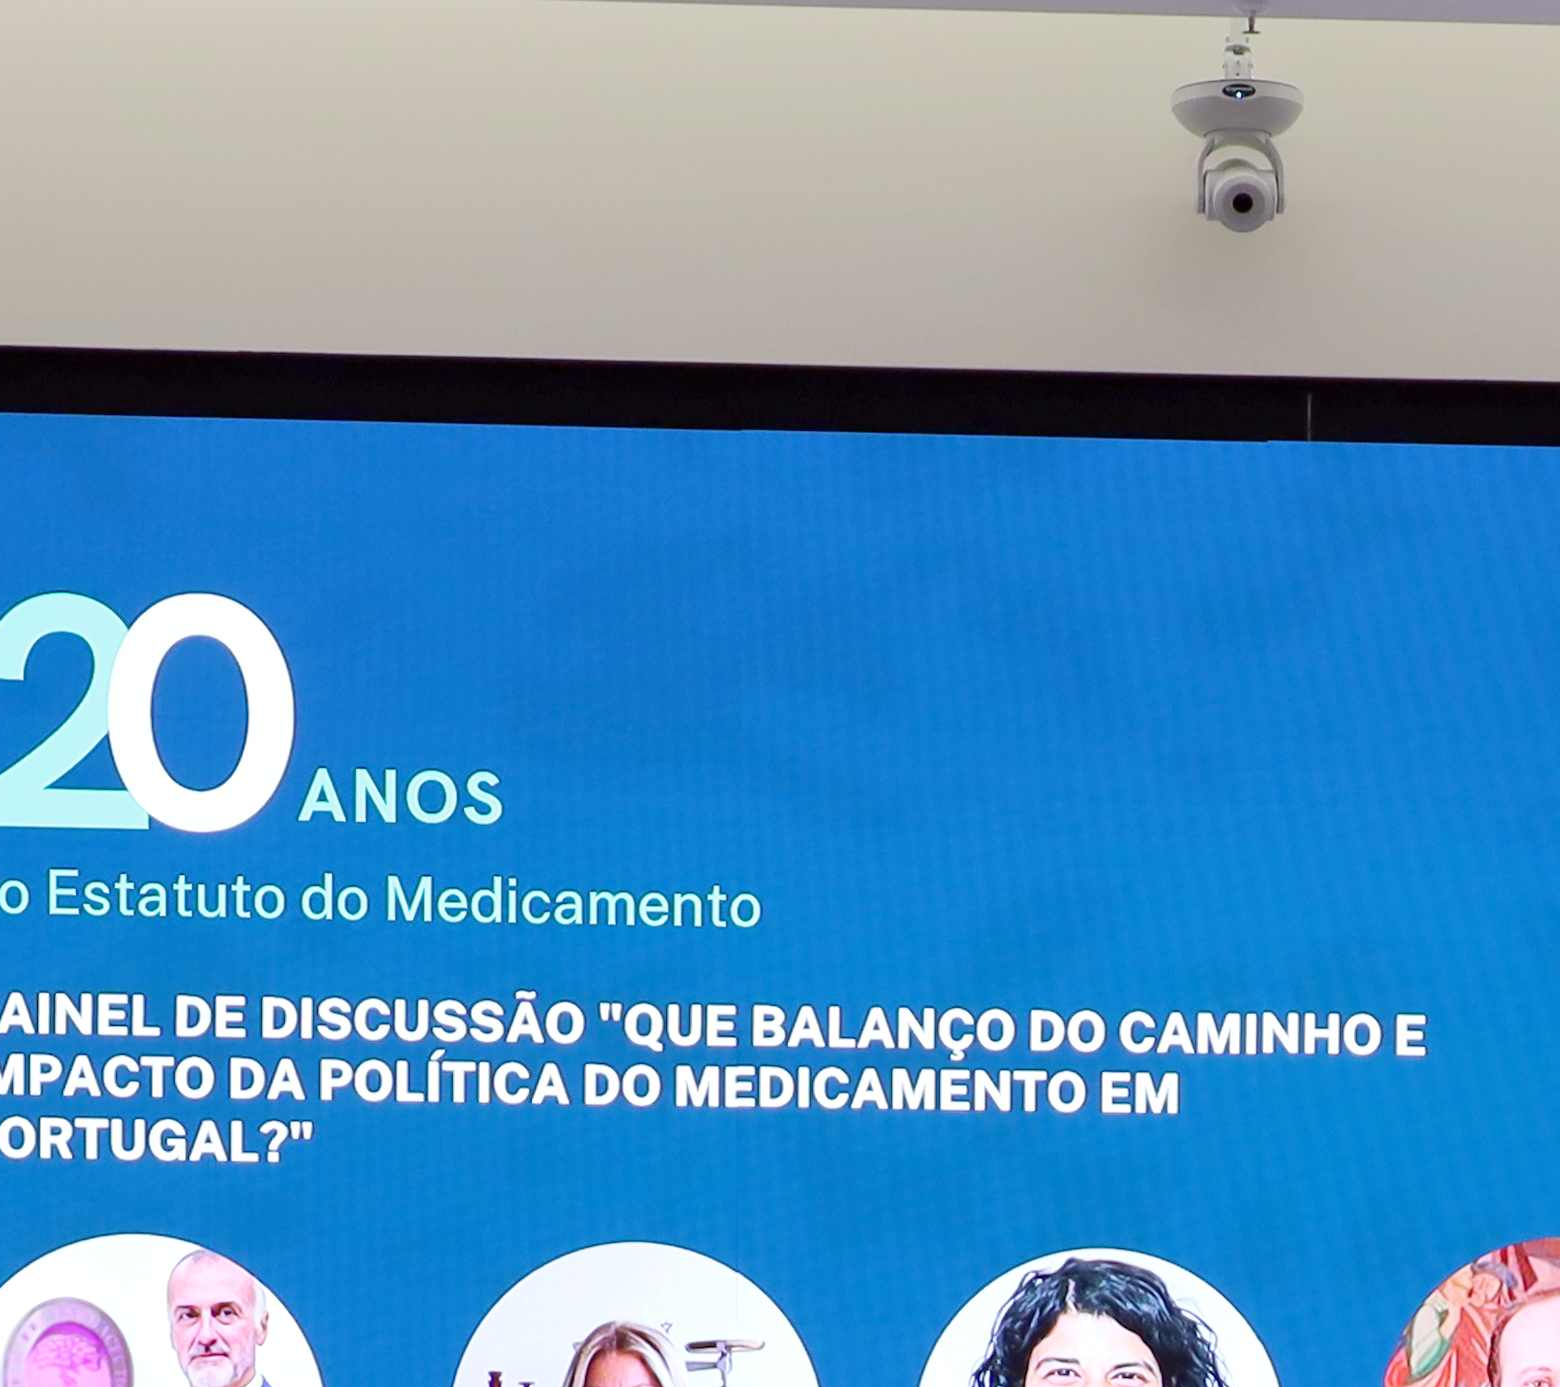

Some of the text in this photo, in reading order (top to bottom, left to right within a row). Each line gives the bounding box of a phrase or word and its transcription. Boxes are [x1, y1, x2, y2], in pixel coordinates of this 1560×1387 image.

[299, 767, 502, 824] ANOS
[48, 867, 284, 919] Estatuto
[301, 872, 369, 921] do
[388, 874, 760, 928] Medicamento
[175, 994, 246, 1039] DE
[261, 990, 585, 1051] DISCUSSÃO
[600, 1002, 737, 1052] "QUE
[753, 1005, 1012, 1061] BALANÇO
[1030, 1008, 1106, 1053] DO
[1119, 1011, 1382, 1057] CAMINHO
[1396, 1013, 1427, 1057] E
[229, 1057, 305, 1100] DA
[319, 1048, 570, 1105] POLÍTICA
[584, 1063, 661, 1108] DO
[676, 1065, 1087, 1114] MEDICAMENTO
[1100, 1071, 1180, 1115] EM
